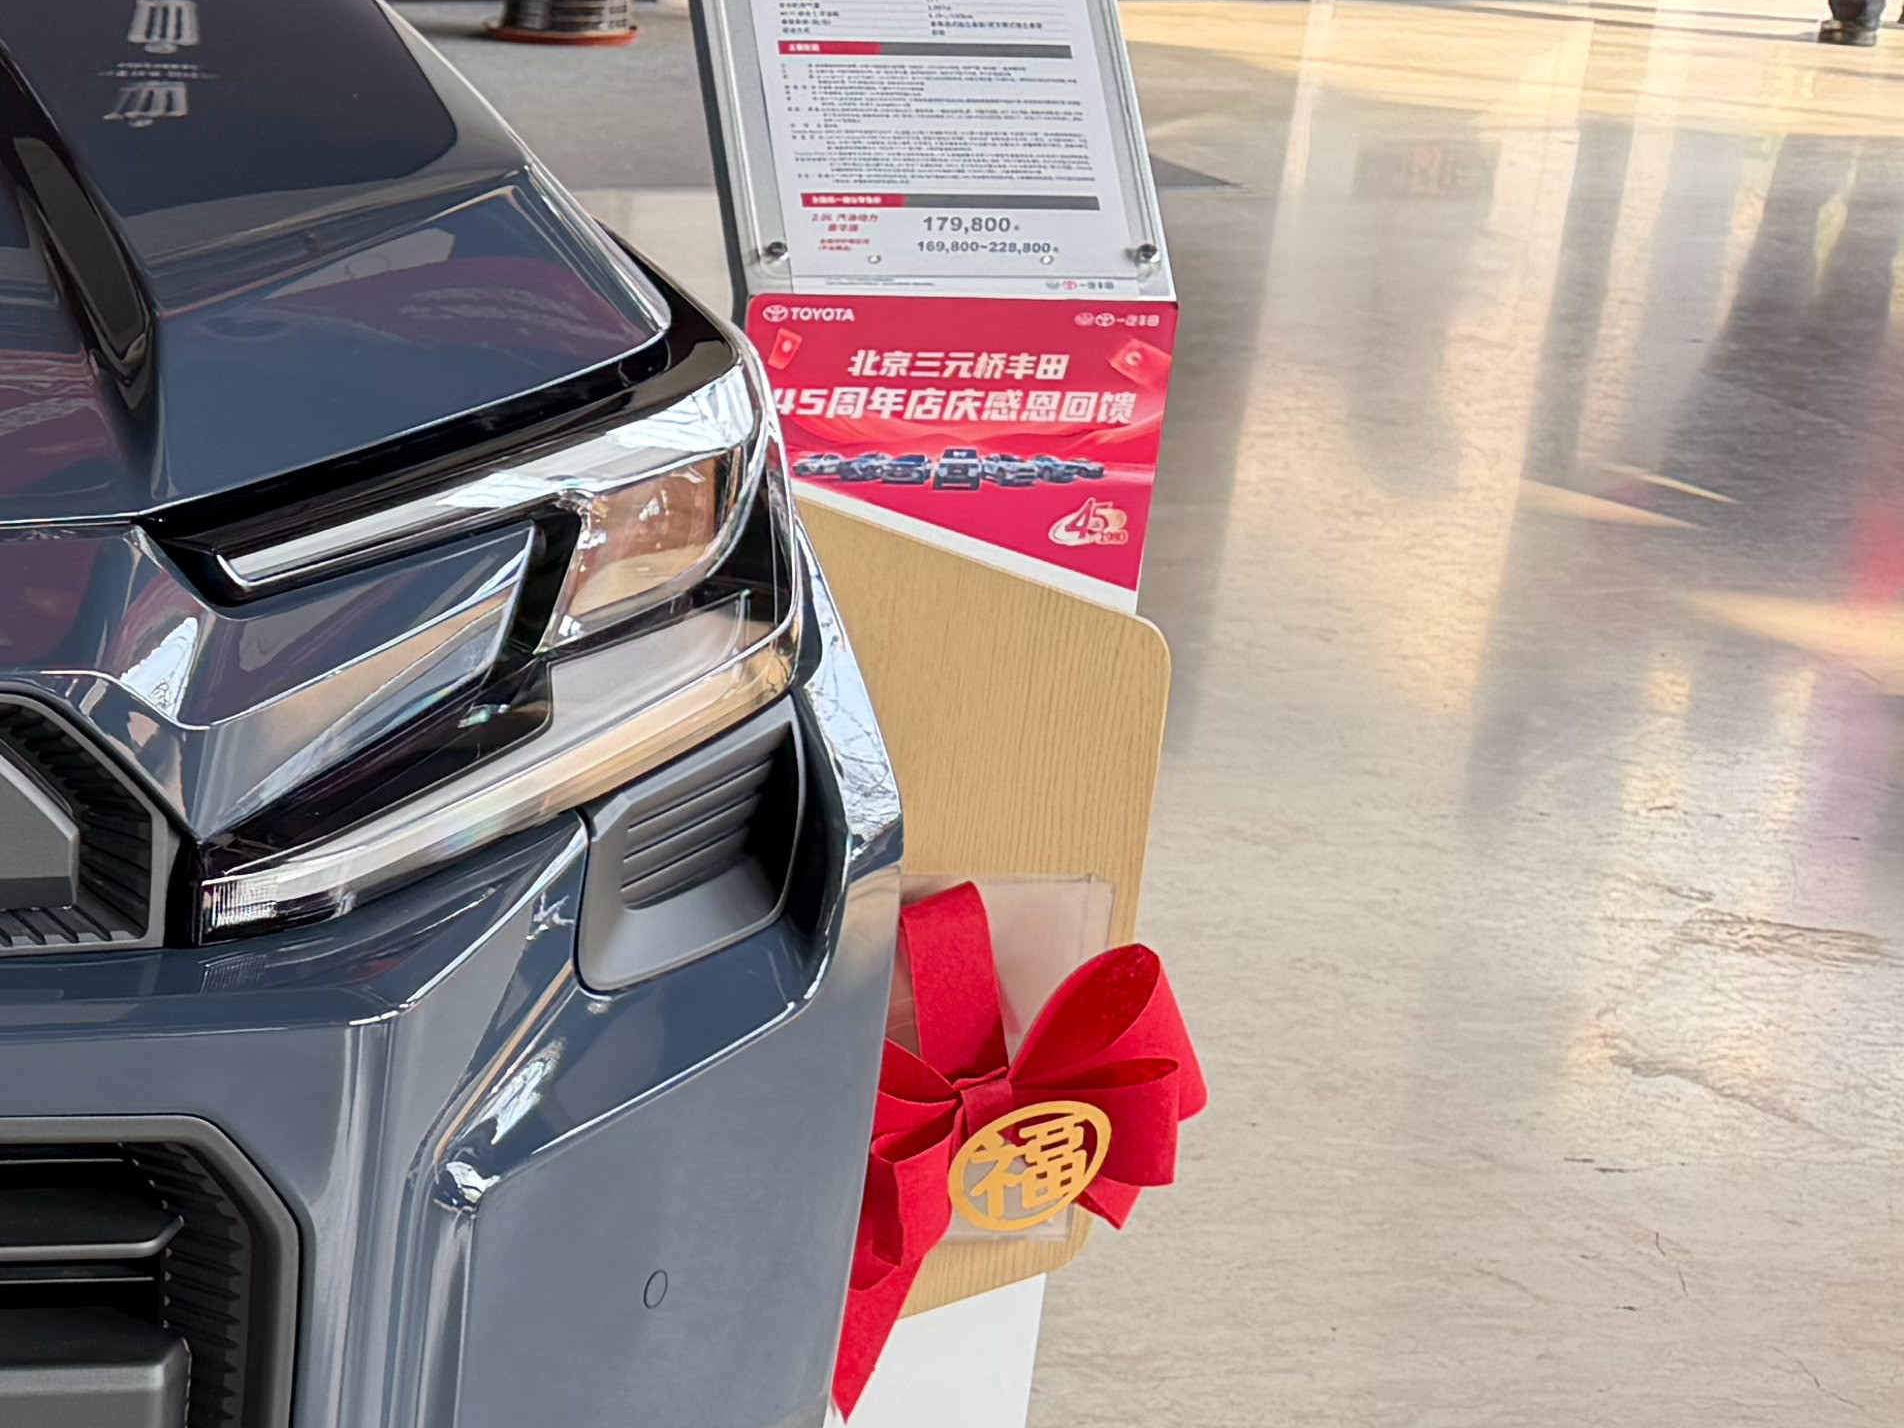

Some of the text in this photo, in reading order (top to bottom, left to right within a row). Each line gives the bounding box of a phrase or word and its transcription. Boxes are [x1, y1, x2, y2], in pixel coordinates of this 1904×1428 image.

[923, 216, 1012, 234] 179,800
[790, 307, 855, 323] TOYOTA
[847, 349, 1071, 381] 北京三元桥丰田
[773, 386, 1138, 425] 45周年店庆感恩回馈
[970, 1114, 1092, 1220] 福
